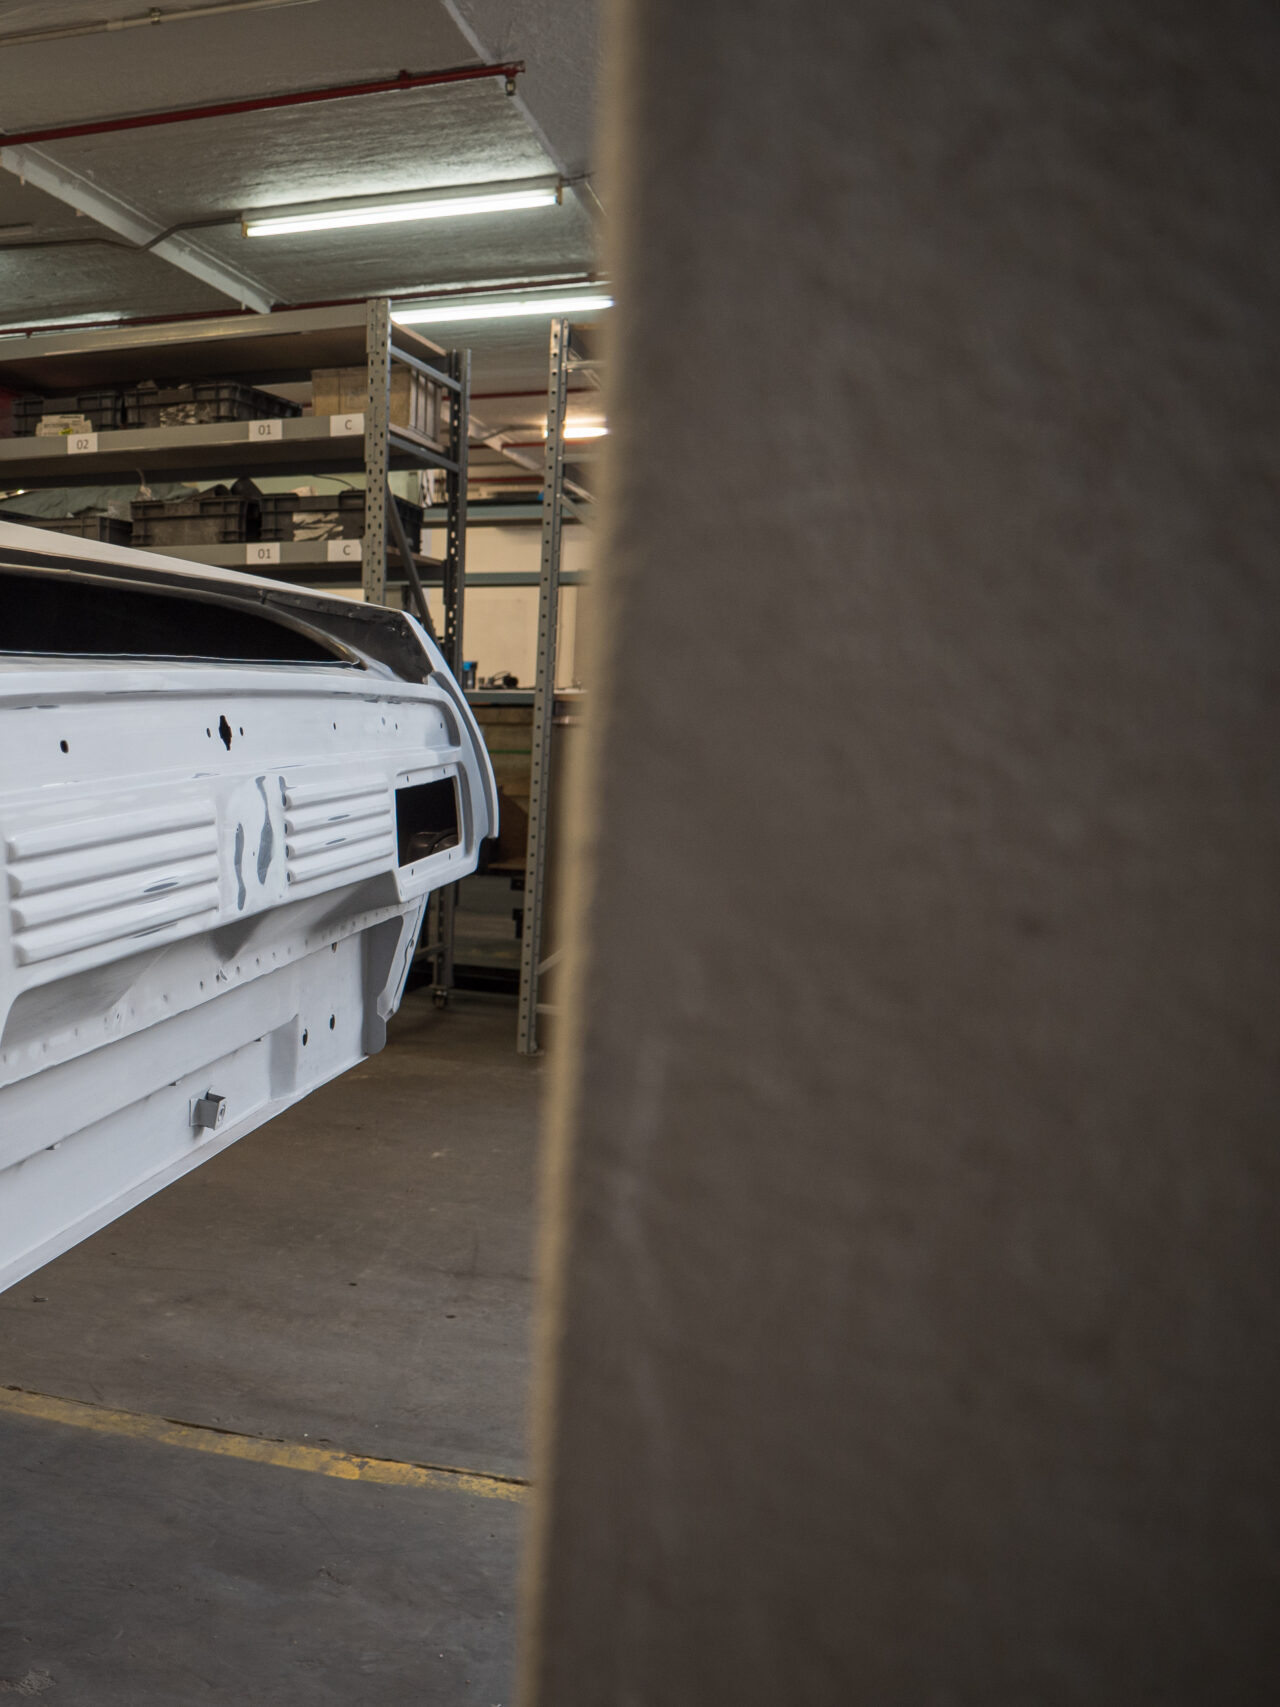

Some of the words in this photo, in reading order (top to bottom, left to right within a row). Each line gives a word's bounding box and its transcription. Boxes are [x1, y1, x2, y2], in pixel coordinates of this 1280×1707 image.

[258, 424, 271, 435] 01
[344, 419, 352, 430] C
[76, 439, 89, 450] 02
[257, 548, 271, 559] 01
[342, 544, 351, 556] C
